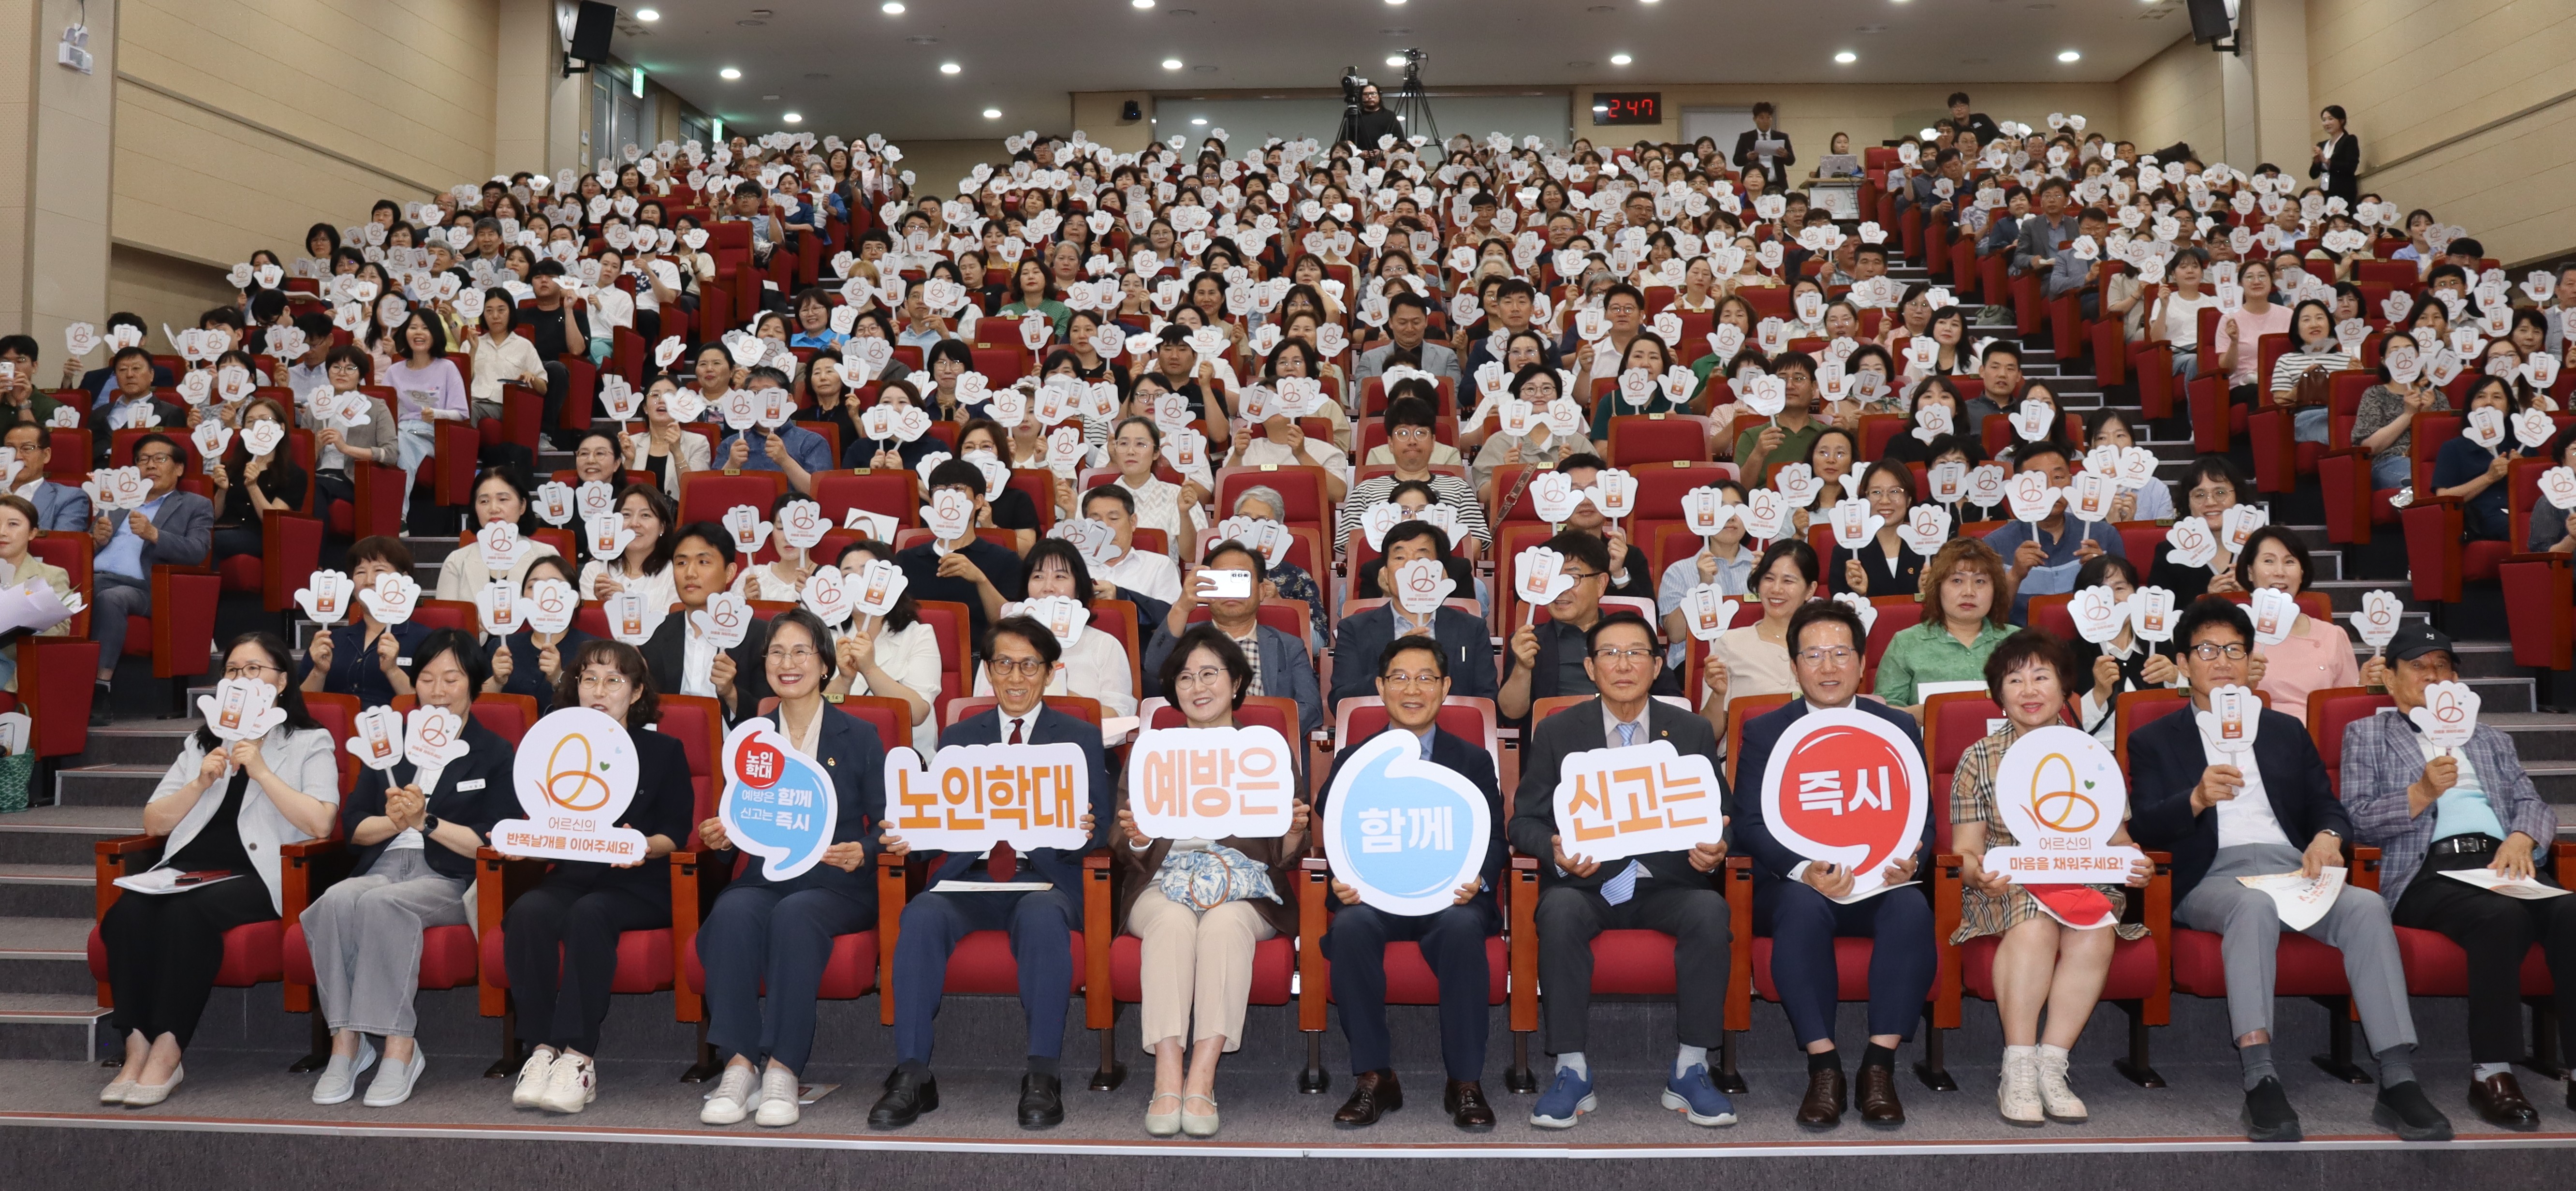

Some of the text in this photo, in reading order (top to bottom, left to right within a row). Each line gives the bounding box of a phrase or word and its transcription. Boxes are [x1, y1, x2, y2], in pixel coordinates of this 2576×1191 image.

[746, 750, 773, 766] 노인
[746, 764, 773, 779] 학대
[1143, 747, 1280, 817] 예방은
[742, 787, 813, 808] 예방은 함께
[899, 765, 1076, 831] 노인학대
[1568, 762, 1708, 842] 신고는
[1798, 766, 1892, 816] 즉시
[548, 816, 596, 833] 어르신의
[741, 807, 810, 832] 신고는 즉시
[1358, 806, 1454, 853] 함께
[507, 832, 634, 855] 반쪽날개를 이어주세요!
[2039, 837, 2092, 851] 어르신의
[2010, 857, 2124, 871] 마음을 채워주세요!
